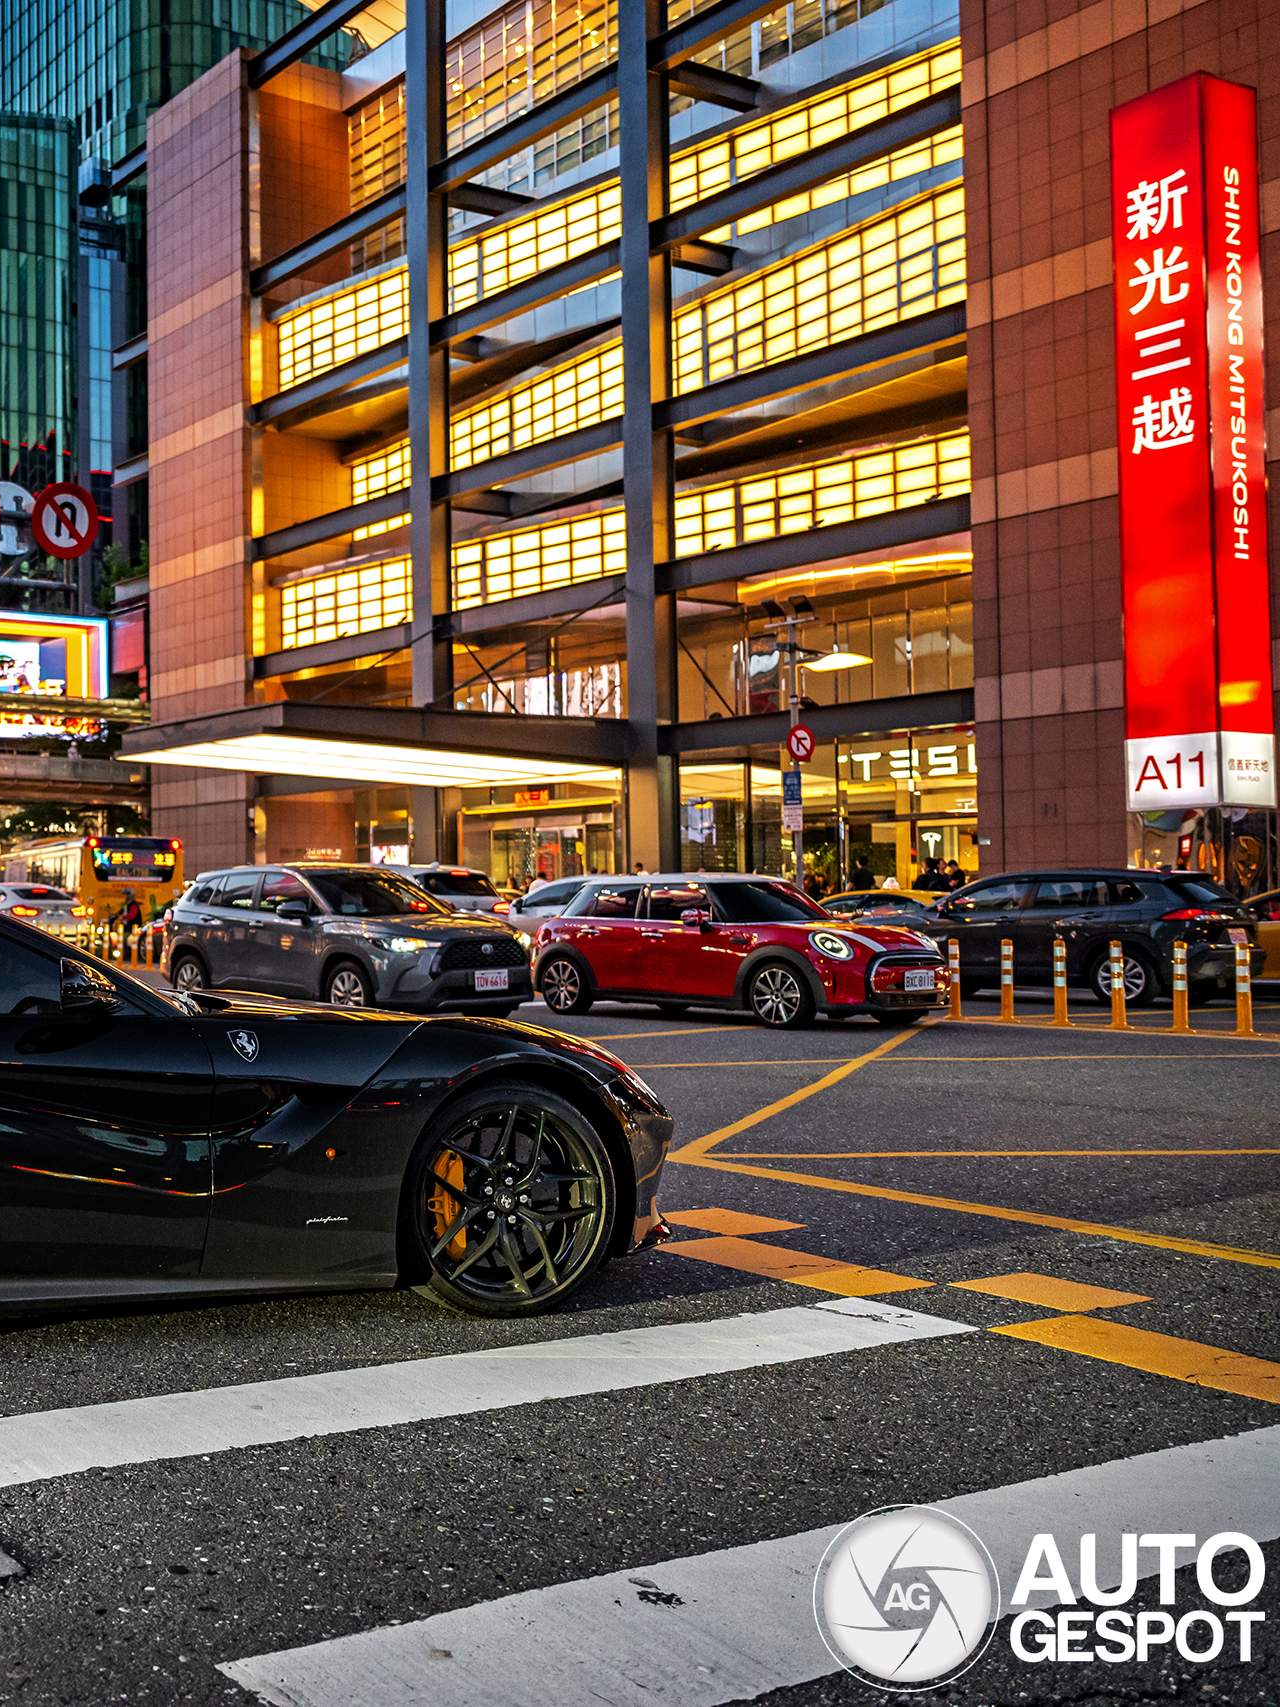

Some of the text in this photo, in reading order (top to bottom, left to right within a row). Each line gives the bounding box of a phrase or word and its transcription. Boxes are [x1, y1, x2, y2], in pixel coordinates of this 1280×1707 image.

[1125, 168, 1195, 455] 新光三越
[1223, 166, 1250, 560] SHIN KONG MITSUKOSHI
[1134, 750, 1205, 792] A11
[1228, 758, 1268, 772] 信義新天地
